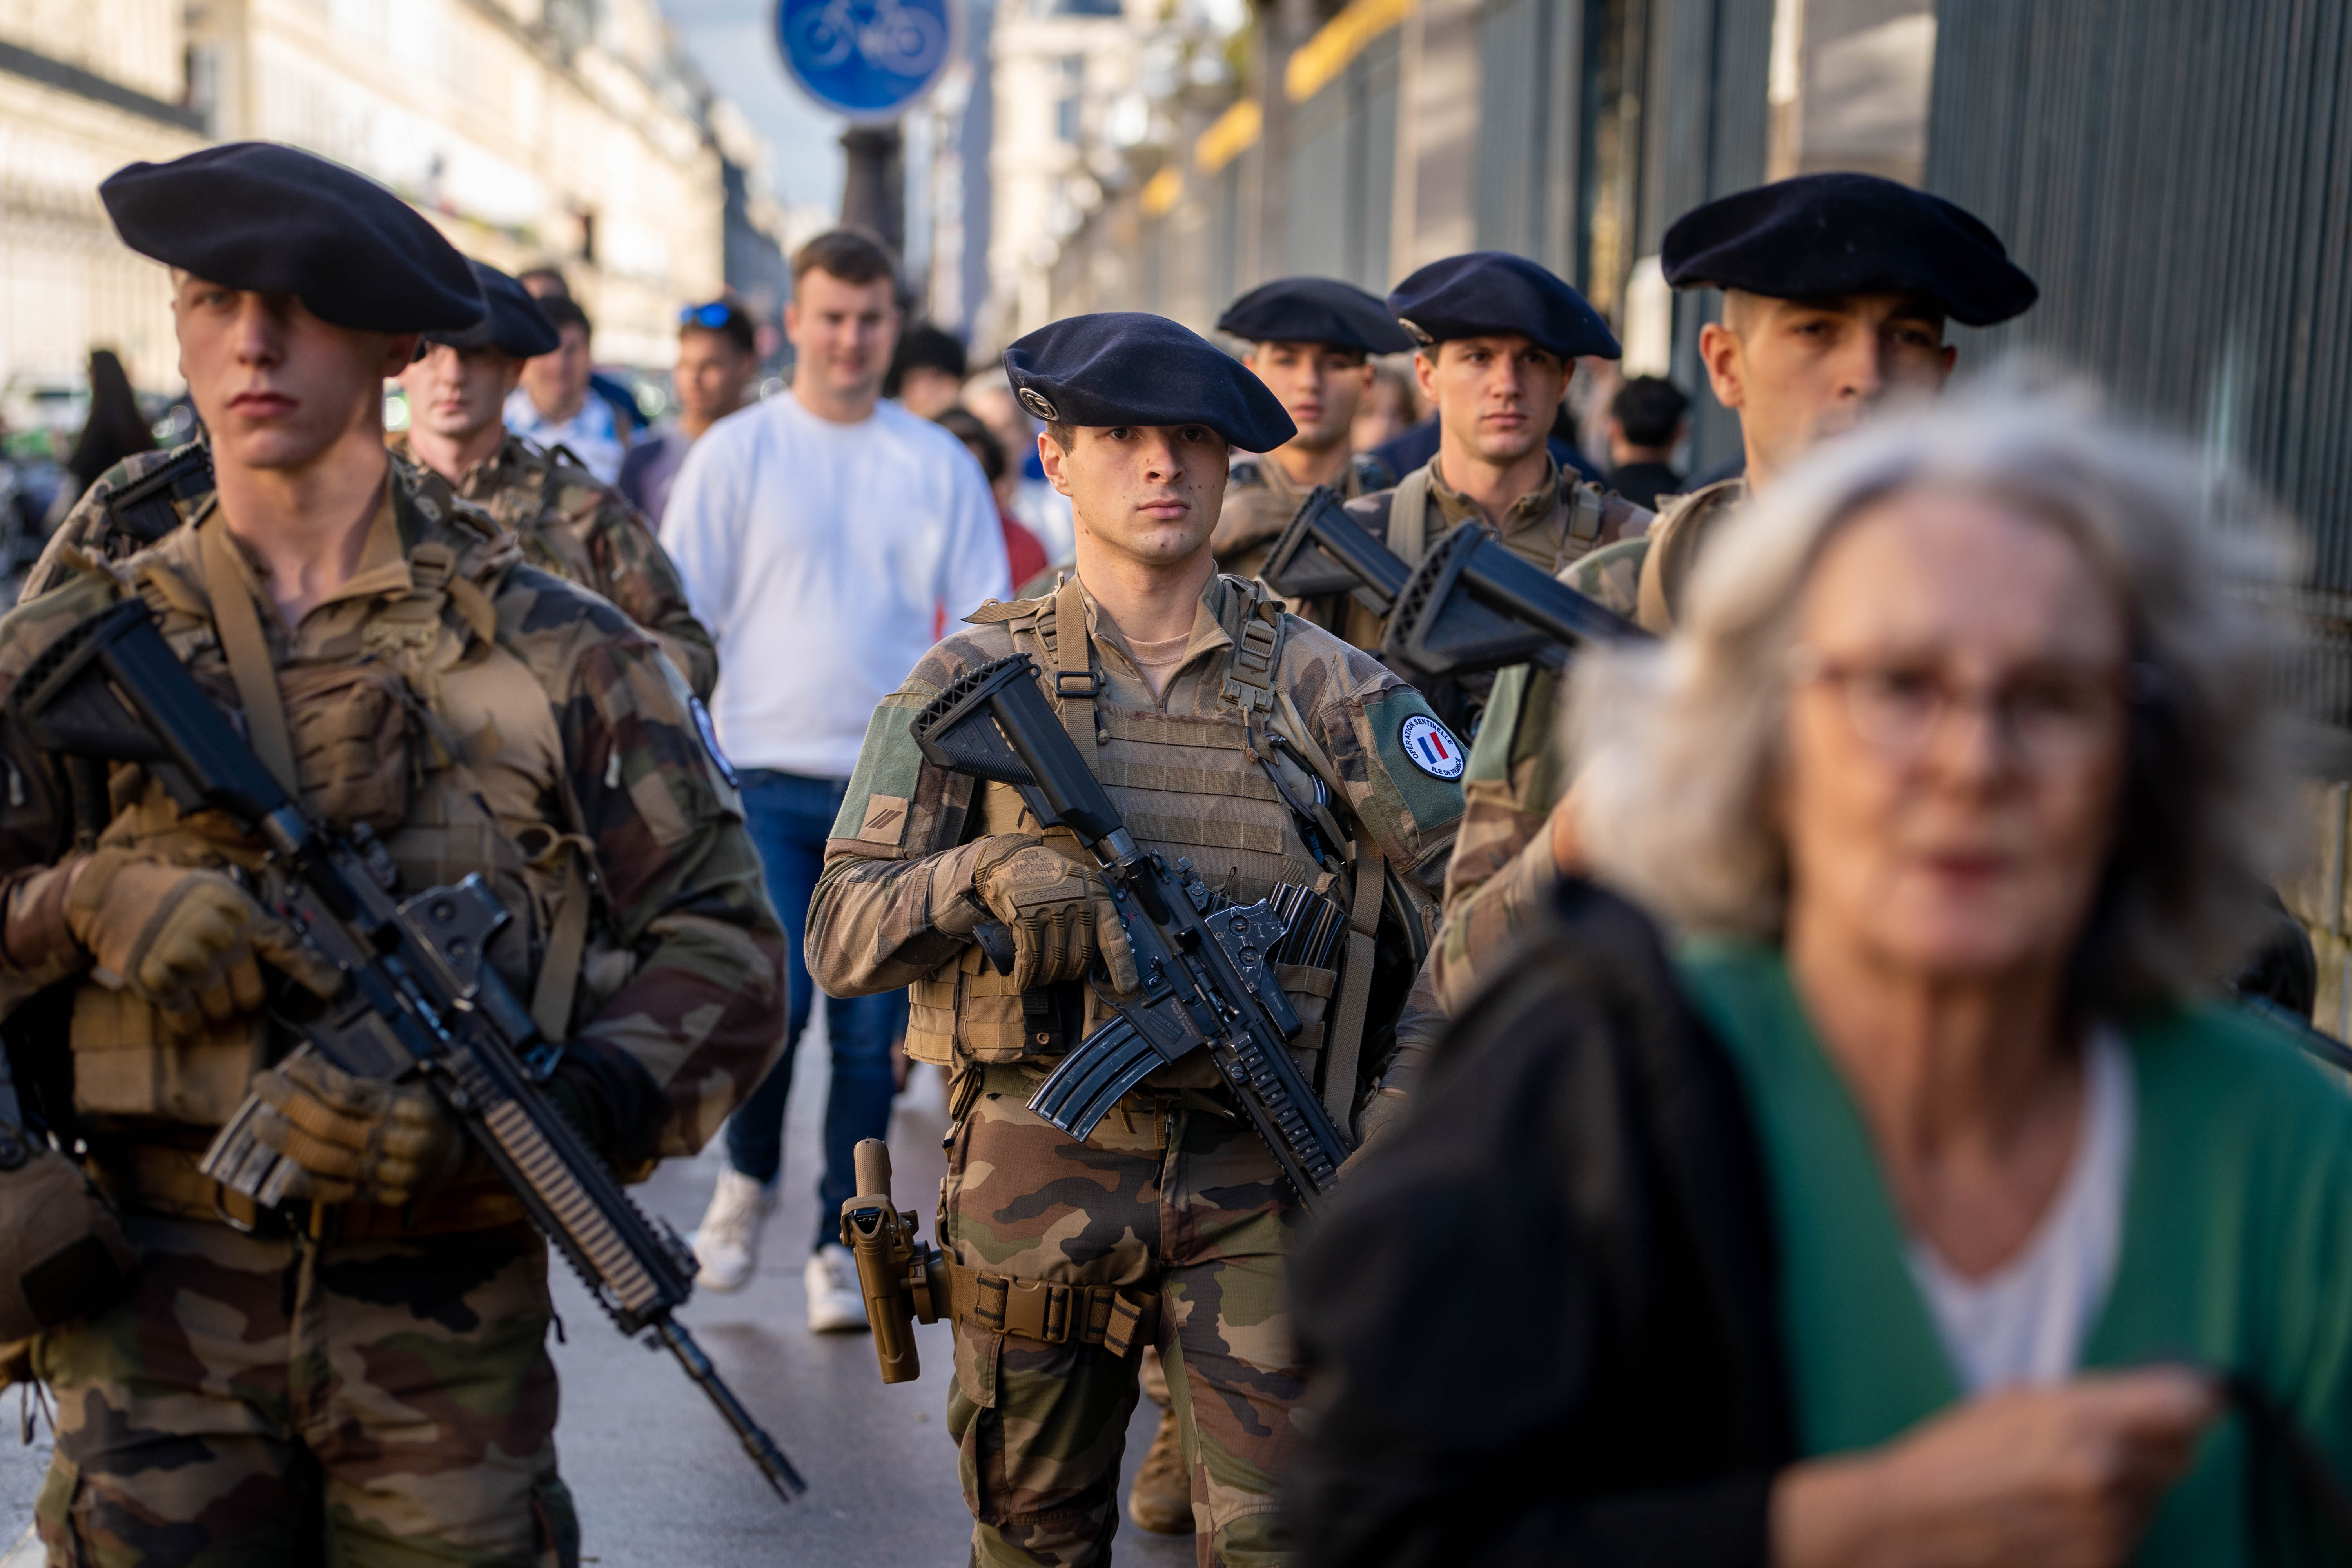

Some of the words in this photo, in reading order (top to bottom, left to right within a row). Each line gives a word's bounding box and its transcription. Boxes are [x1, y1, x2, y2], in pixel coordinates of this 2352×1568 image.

[1414, 718, 1453, 745] SENTINELLE
[1451, 757, 1461, 775] FRANCE
[1012, 860, 1054, 876] Mechanix
[1172, 997, 1183, 1013] Heckler
[1170, 1004, 1178, 1014] Made
[1180, 1019, 1191, 1036] Germany
